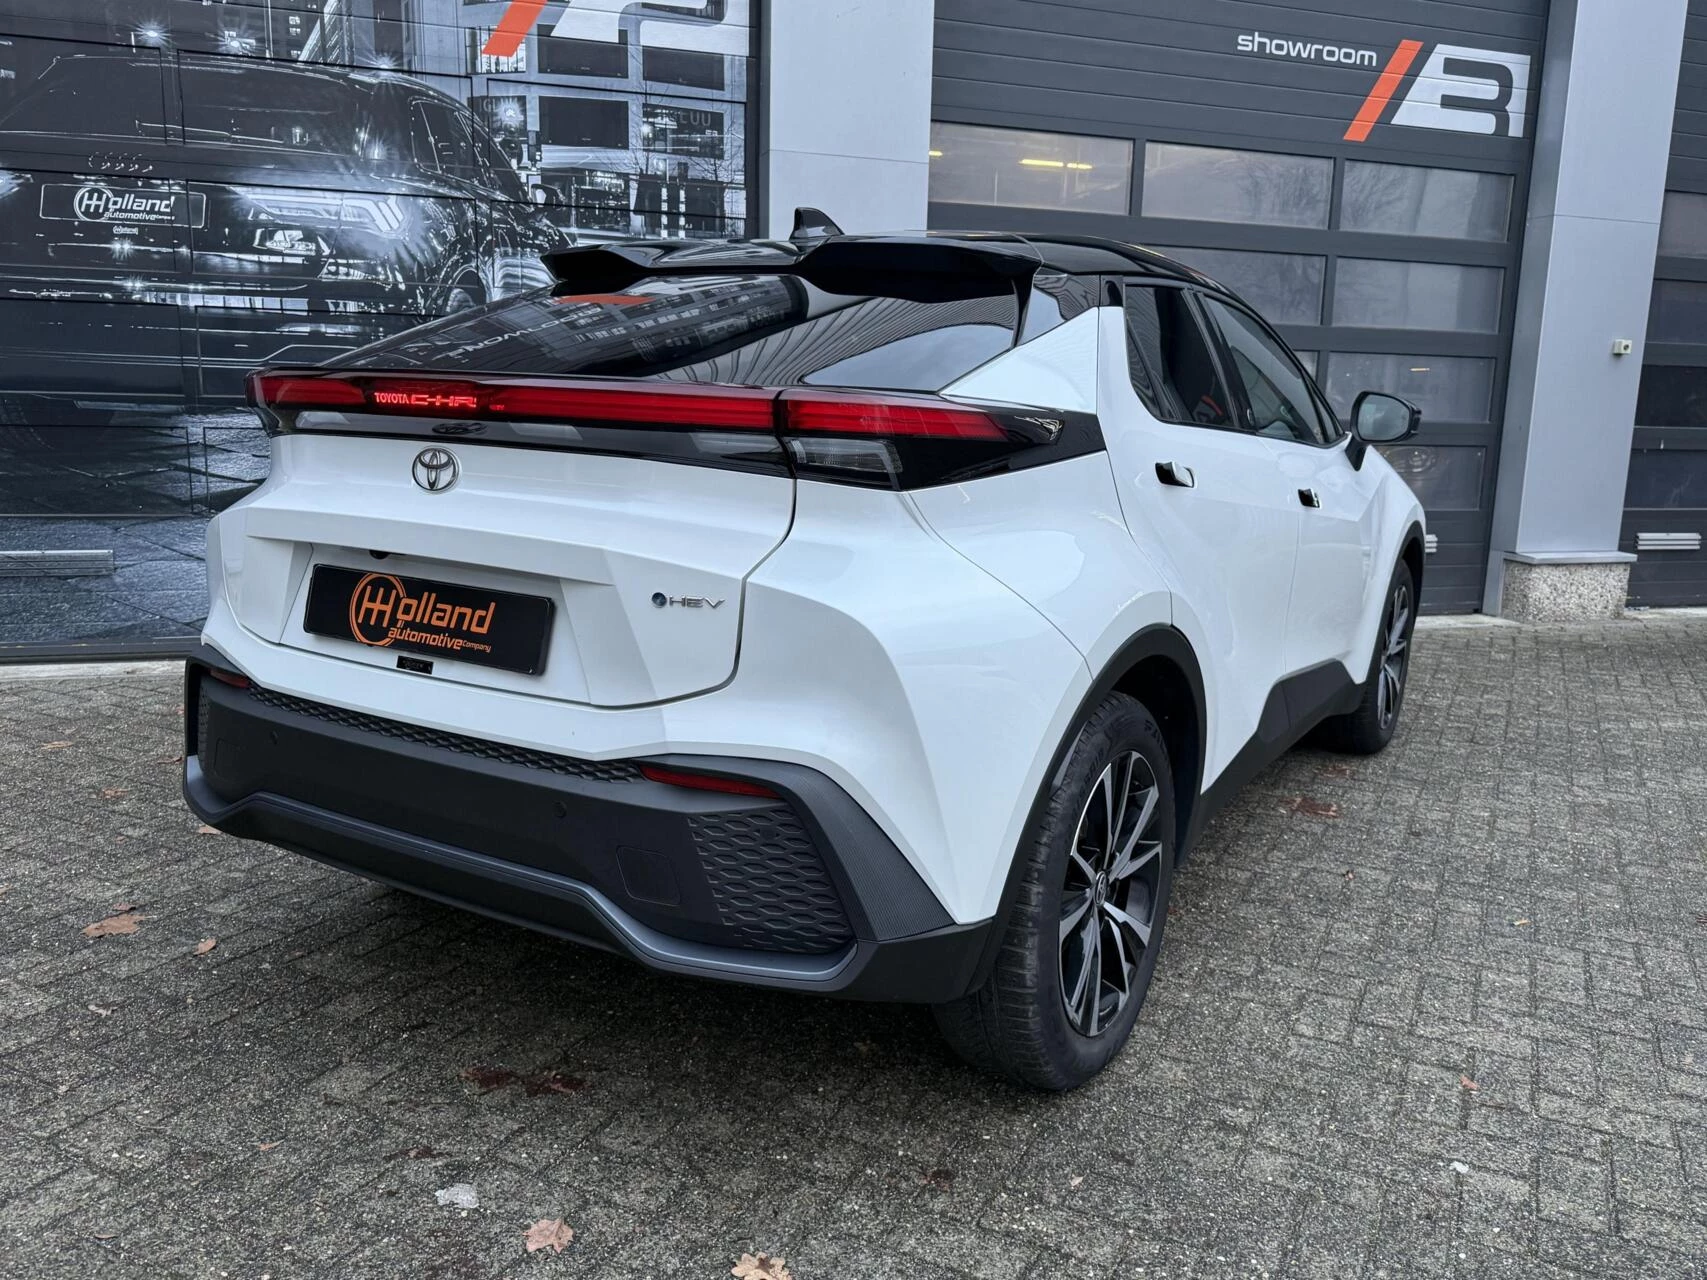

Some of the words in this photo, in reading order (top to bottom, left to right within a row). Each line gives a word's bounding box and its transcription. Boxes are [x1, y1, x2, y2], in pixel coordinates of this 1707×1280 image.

[1237, 32, 1377, 66] showroom
[104, 210, 156, 220] automotive
[374, 392, 409, 404] TOYOTA
[411, 394, 477, 408] C-HR
[355, 582, 496, 635] Holland
[668, 595, 726, 609] HEV
[387, 626, 462, 651] automotive
[462, 640, 491, 653] Company
